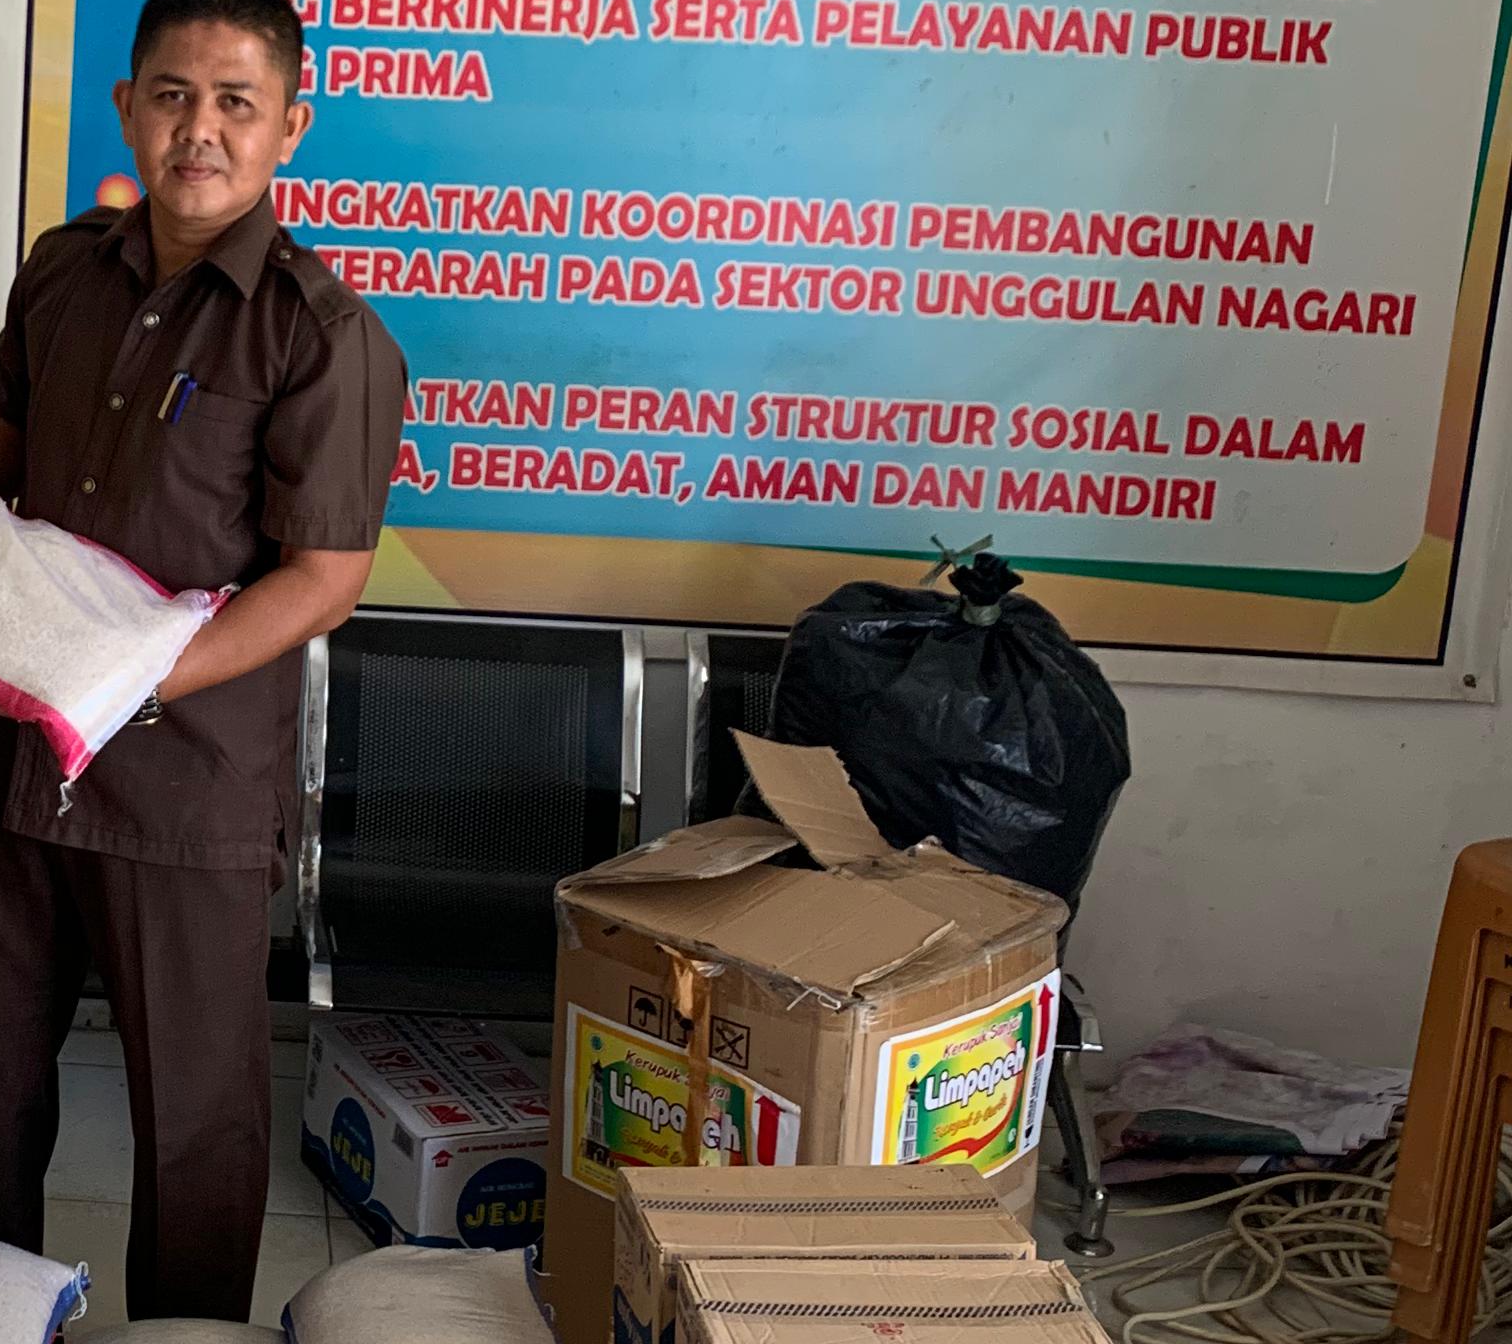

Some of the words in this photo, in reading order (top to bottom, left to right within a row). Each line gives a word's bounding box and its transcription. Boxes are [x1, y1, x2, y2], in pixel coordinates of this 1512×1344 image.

[813, 0, 1132, 56] PELAYANAN
[1145, 14, 1333, 65] PUBLIK
[327, 48, 492, 100] PRIMA
[274, 179, 571, 237] INGKATKAN
[582, 189, 898, 246] KOORDINASI
[908, 206, 1314, 266] PEMBANGUNAN
[559, 255, 700, 304] PADA
[713, 261, 902, 315] SEKTOR
[915, 269, 1201, 327] UNGGULAN
[1218, 284, 1415, 336] NAGARI
[564, 386, 734, 436] PERAN
[746, 392, 996, 446] STRUKTUR
[1008, 405, 1169, 454] SOSIAL
[1183, 413, 1365, 463] DALAM
[451, 444, 692, 504] BERADAT,
[705, 455, 859, 506] AMAN
[873, 462, 985, 510] DAN
[997, 470, 1216, 520] MANDIRI
[625, 1050, 681, 1082] Kerupuk
[924, 1040, 1026, 1111] Limpapeh
[609, 1068, 742, 1153] Limpaeh
[465, 1199, 546, 1229] JEJE
